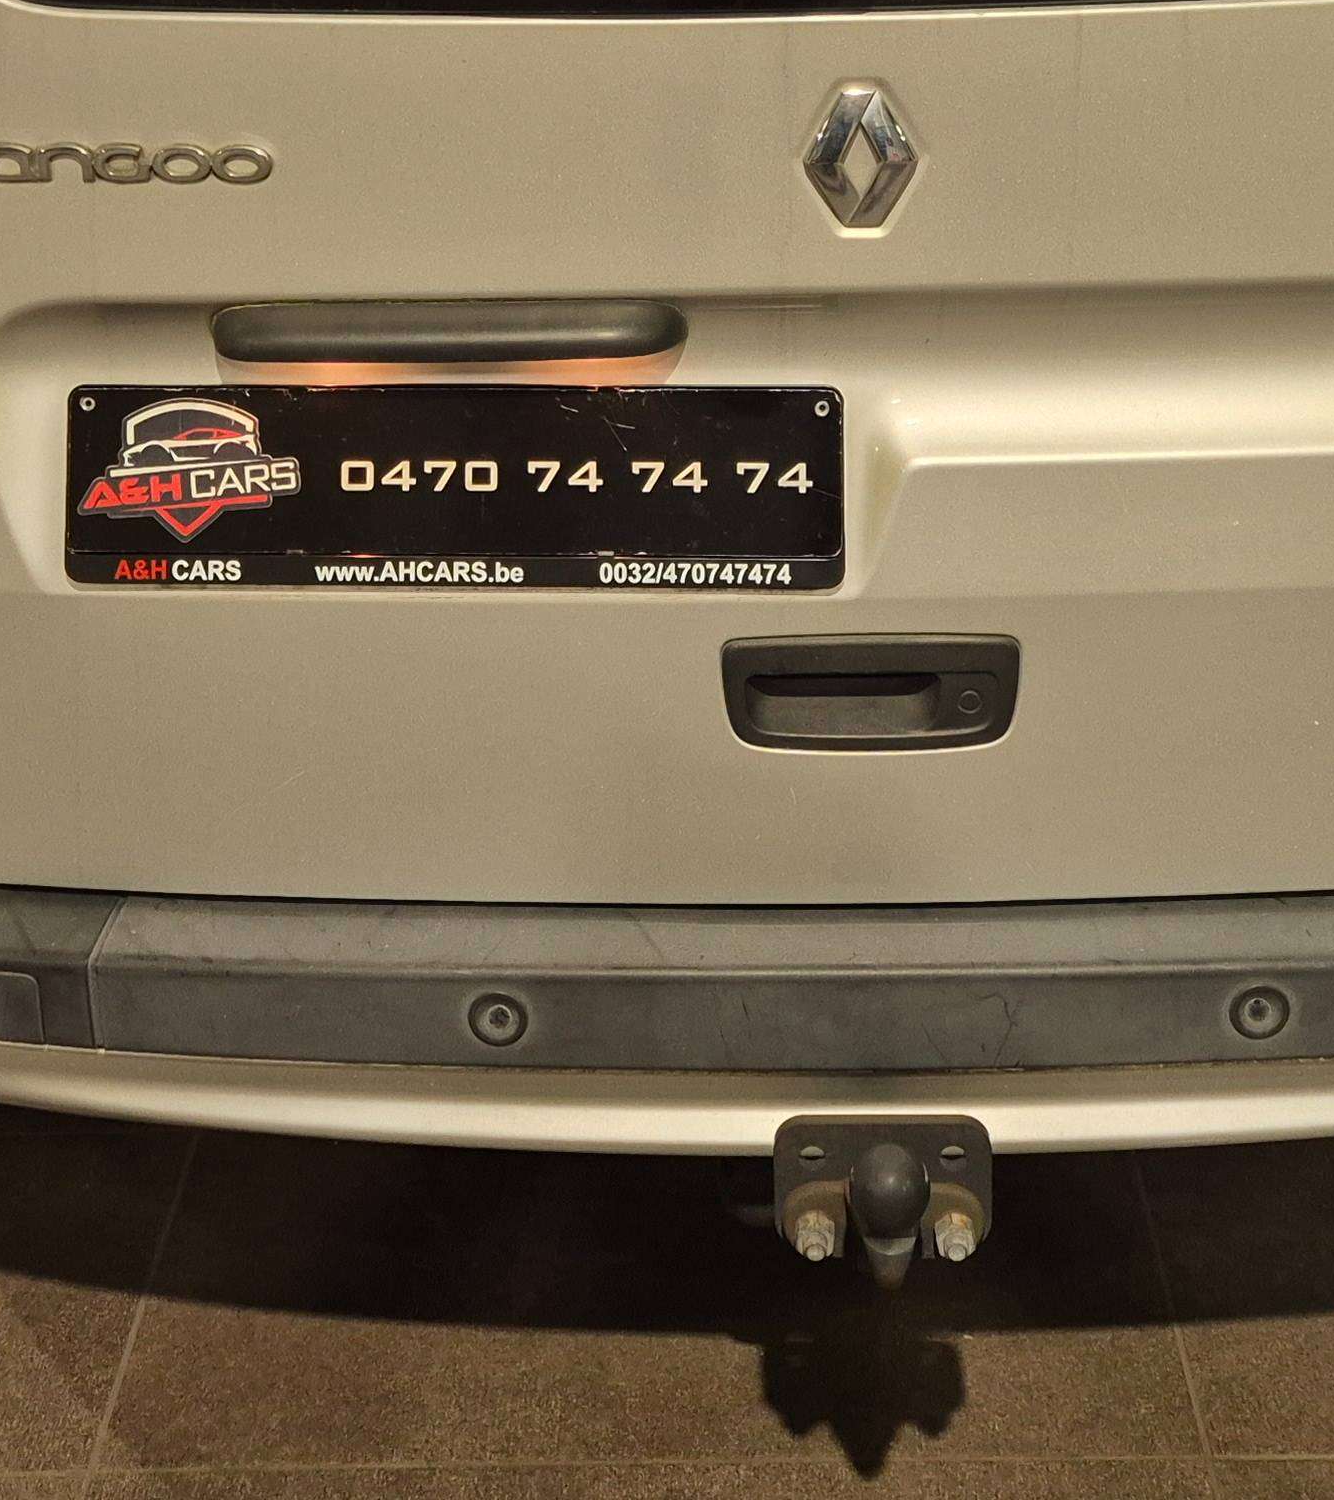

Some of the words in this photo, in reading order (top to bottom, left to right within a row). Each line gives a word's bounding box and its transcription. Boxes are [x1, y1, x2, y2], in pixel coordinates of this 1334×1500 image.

[83, 473, 183, 509] A&H
[190, 461, 298, 498] CARS
[340, 459, 499, 493] 0470
[527, 460, 604, 493] 74
[631, 461, 708, 494] 74
[736, 461, 814, 495] 74
[114, 559, 168, 581] A&H
[171, 559, 242, 581] CARS
[315, 561, 524, 585] www.AHCARS.be
[599, 562, 792, 586] 0032/470747474
